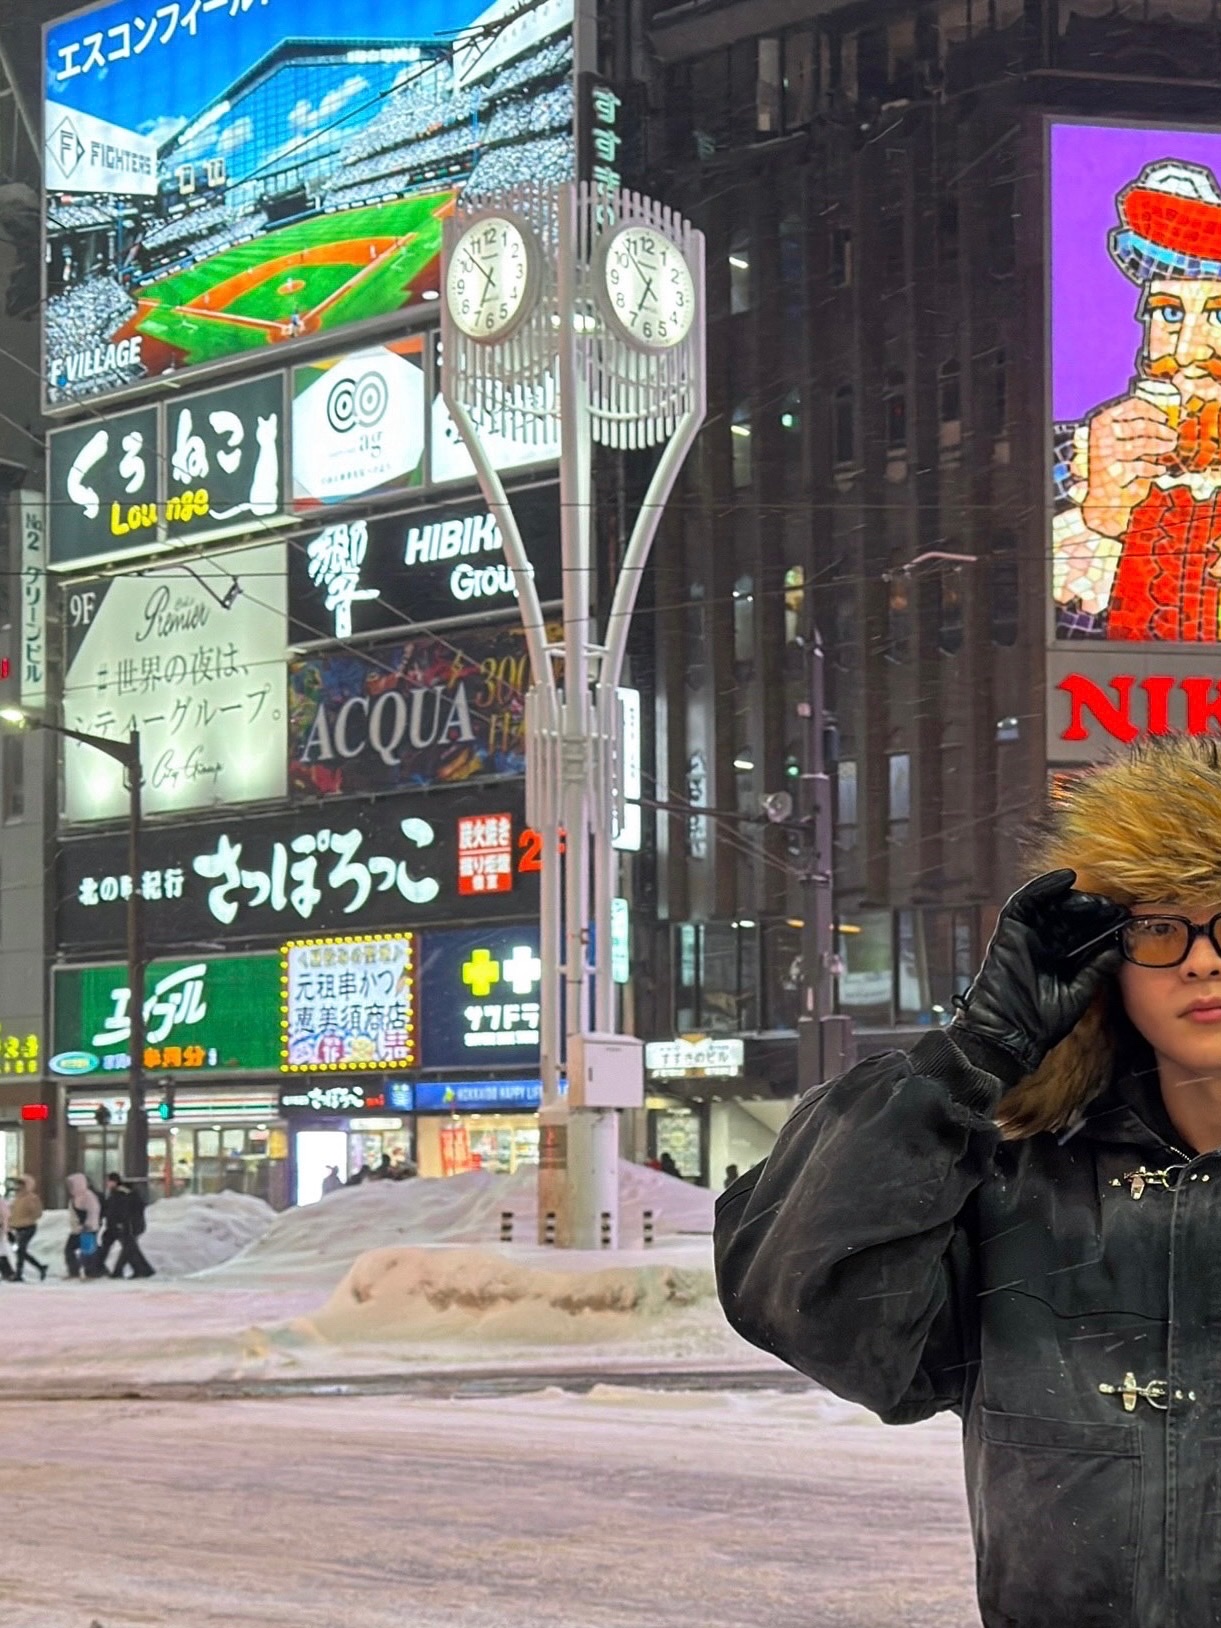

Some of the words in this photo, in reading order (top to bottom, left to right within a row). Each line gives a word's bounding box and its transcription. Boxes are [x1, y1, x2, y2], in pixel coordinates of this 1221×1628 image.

[57, 0, 268, 80] エスコンフィー
[91, 140, 152, 175] FIGHTERS
[483, 228, 497, 244] 12
[501, 231, 507, 247] 1
[470, 238, 481, 254] 11
[511, 243, 519, 258] 2
[625, 238, 638, 256] 11
[641, 236, 655, 255] 12
[614, 251, 629, 268] 10
[660, 250, 666, 266] 1
[516, 263, 523, 279] 3
[611, 269, 619, 285] 9
[671, 268, 680, 284] 2
[457, 279, 465, 295] 9
[616, 292, 625, 308] 8
[676, 291, 684, 307] 3
[474, 310, 482, 326] 7
[499, 303, 508, 319] 5
[629, 310, 638, 327] 7
[669, 311, 678, 325] 4
[485, 312, 495, 329] 6
[658, 320, 667, 337] 5
[643, 321, 652, 338] 6
[66, 336, 142, 381] VILLAGE
[67, 408, 244, 519] くろねこ
[110, 488, 209, 536] Lounge
[70, 592, 97, 627] 9F
[300, 682, 476, 766] ACQUA
[193, 817, 439, 924] さっぽろっこ
